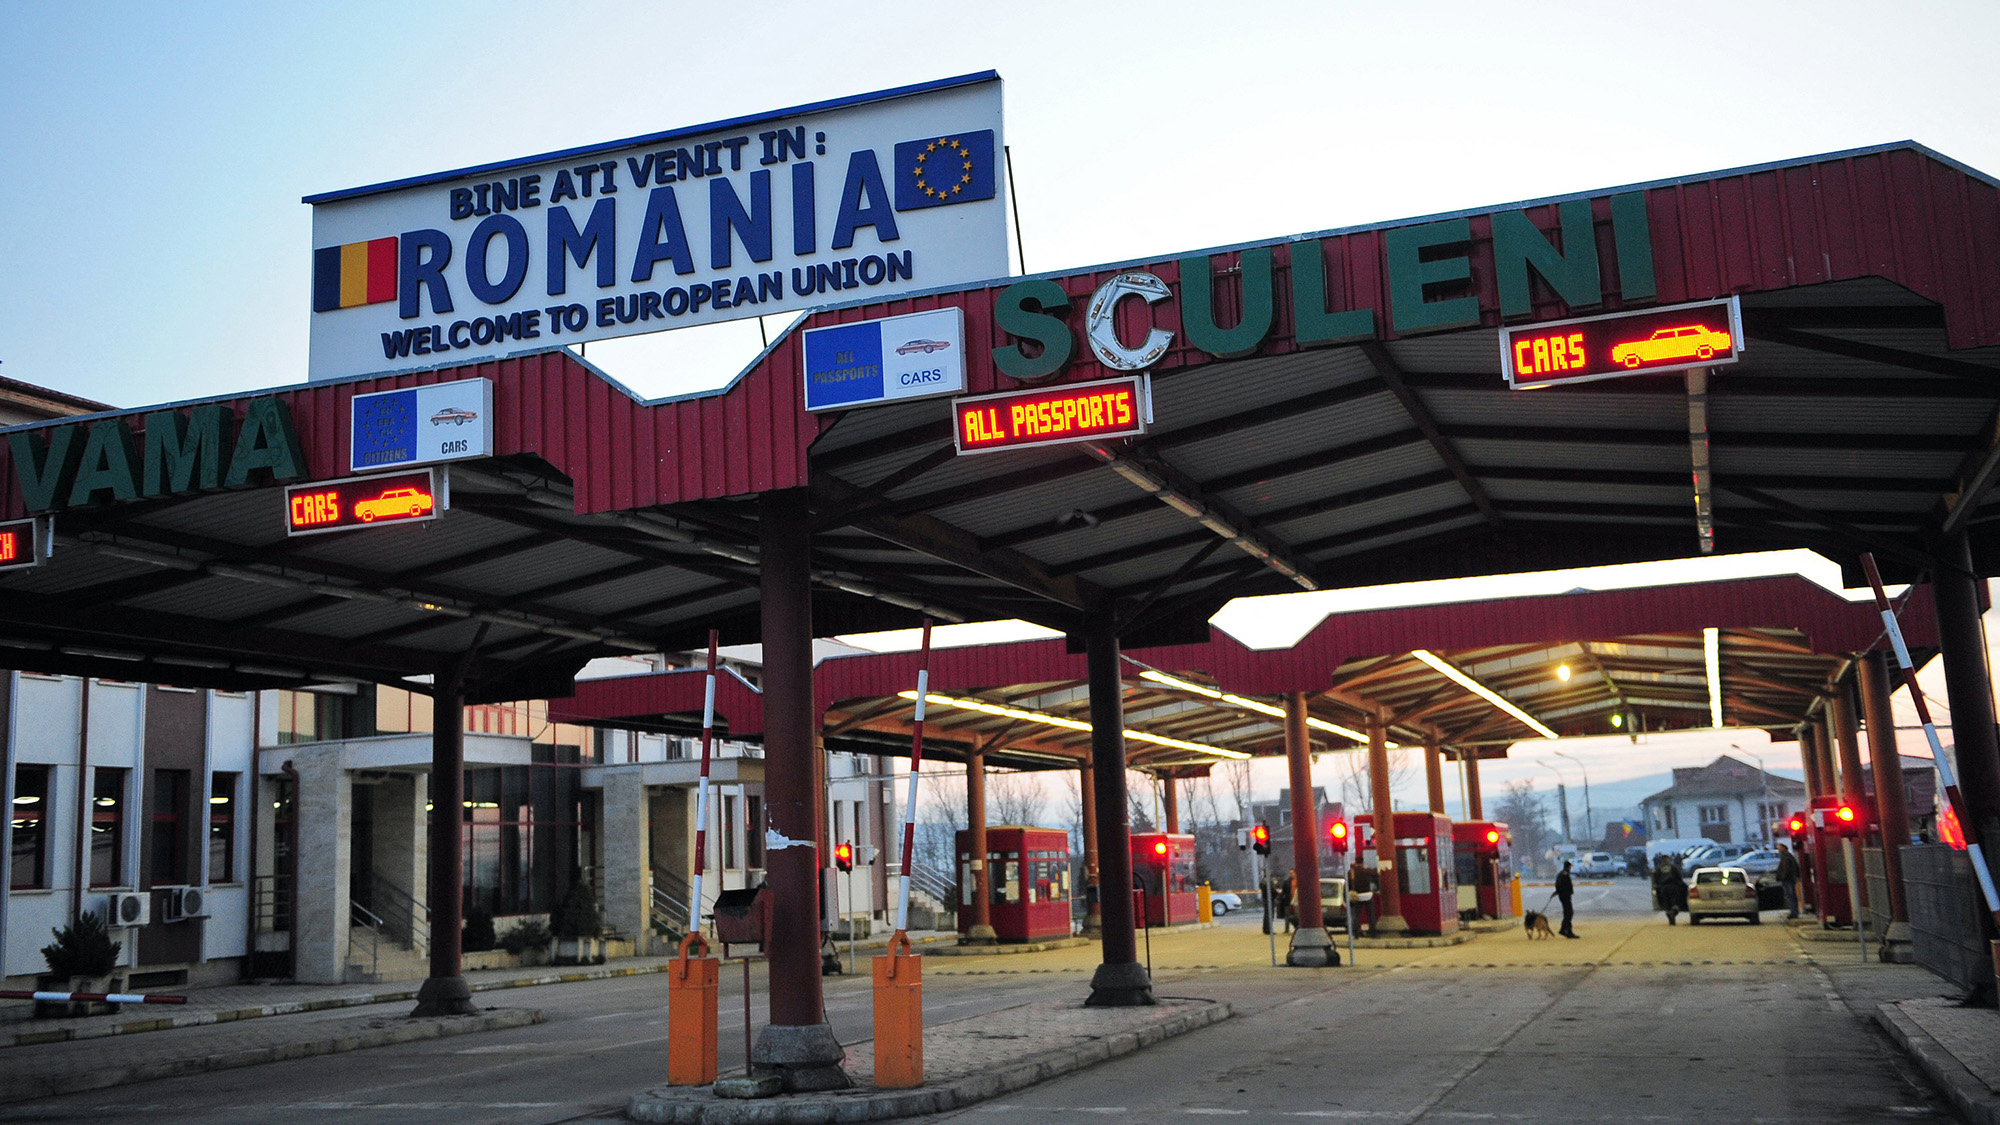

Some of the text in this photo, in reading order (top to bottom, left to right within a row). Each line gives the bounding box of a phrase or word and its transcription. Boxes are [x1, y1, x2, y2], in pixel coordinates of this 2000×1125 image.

[450, 174, 541, 220] BINE
[550, 161, 617, 203] ATI
[627, 136, 749, 188] VENIT
[399, 149, 900, 320] ROMANIA
[381, 249, 913, 360] WELCOME TO EUROPEAN UNION
[991, 192, 1658, 381] SCULENI
[813, 364, 879, 385] PASSPORTS
[836, 350, 854, 365] ALL
[1515, 332, 1586, 375] CARS
[900, 369, 942, 386] CARS
[965, 391, 1131, 442] ALL PASSPORTS
[8, 396, 302, 512] VAMA
[363, 447, 408, 465] CITIZENS
[441, 439, 469, 455] CARS
[291, 492, 339, 525] CARS
